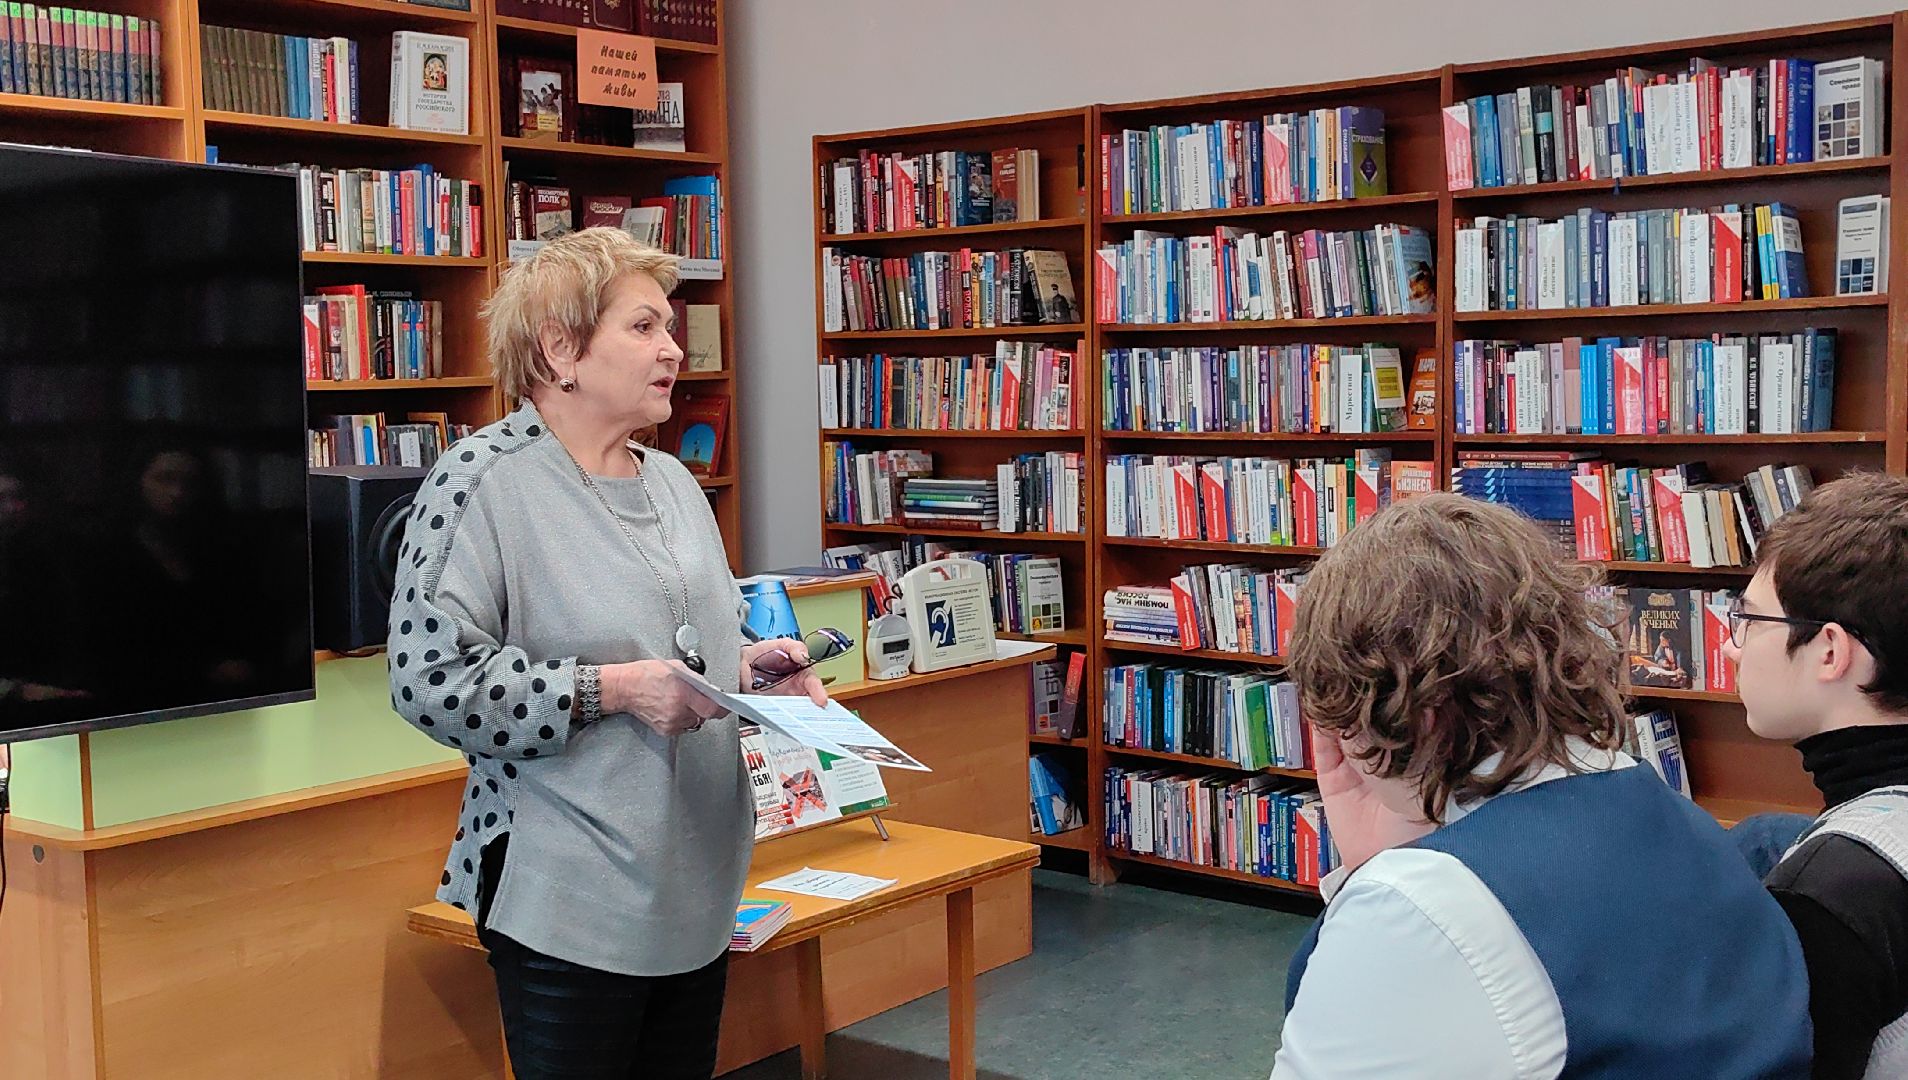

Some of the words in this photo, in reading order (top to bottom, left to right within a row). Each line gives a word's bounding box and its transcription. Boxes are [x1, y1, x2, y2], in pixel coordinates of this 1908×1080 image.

[600, 45, 638, 61] Нашей
[590, 65, 647, 80] памятью
[602, 82, 637, 98] живы
[537, 194, 560, 204] ПОЛК
[1687, 219, 1699, 248] право
[1687, 249, 1696, 297] Земельное
[1345, 372, 1354, 421] Маркетинг
[1396, 477, 1432, 492] БИЗНЕСА
[1134, 599, 1169, 609] ПОМЯНИ
[1641, 610, 1680, 620] ВЕЛИКИХ
[1643, 619, 1679, 629] УЧЕНЫХ
[752, 772, 773, 787] ЕБЯ!
